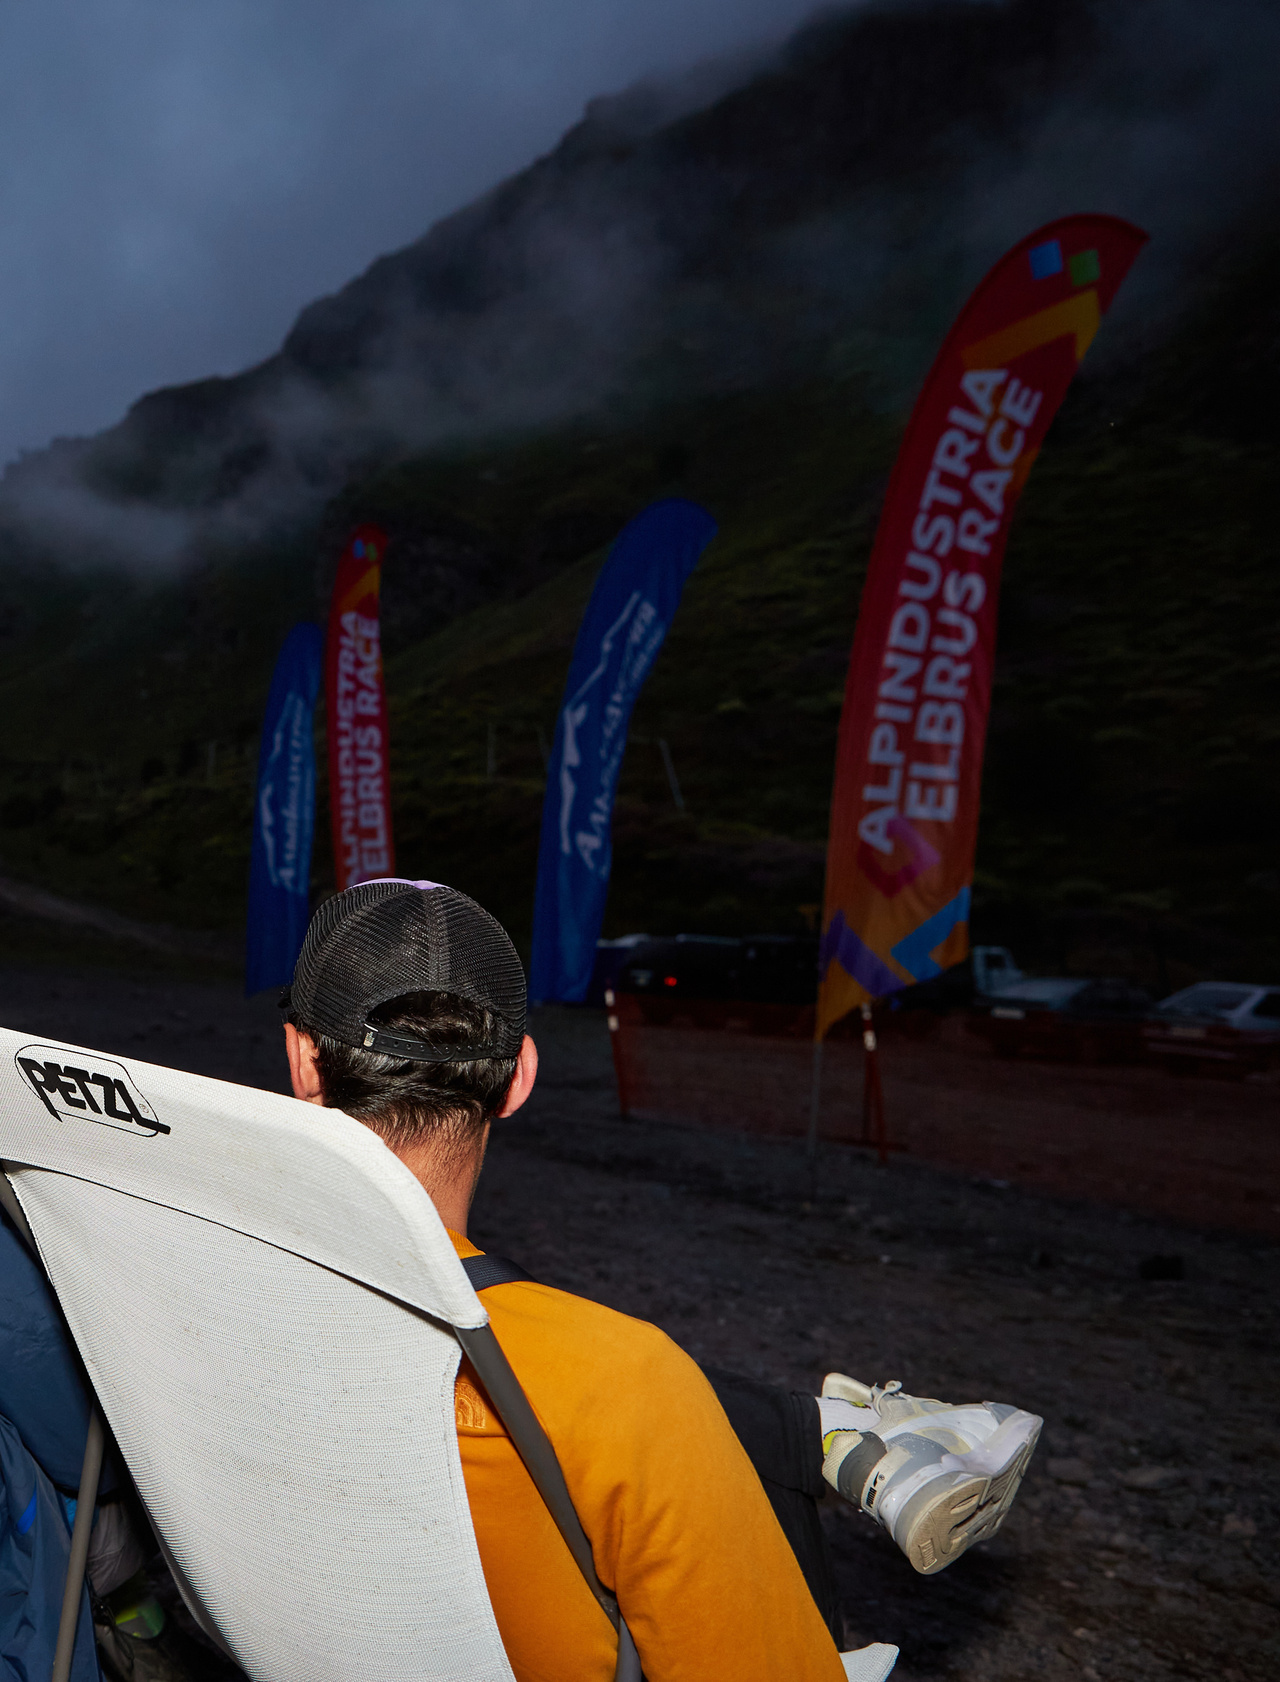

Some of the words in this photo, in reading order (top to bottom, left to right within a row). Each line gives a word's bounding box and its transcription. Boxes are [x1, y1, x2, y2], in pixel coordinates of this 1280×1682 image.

[354, 617, 382, 717] RACE
[858, 369, 1008, 855] ALPINDUSTRIA
[904, 570, 987, 823] ELBRUS
[956, 379, 1042, 557] RACE
[355, 723, 390, 874] ELBRUS
[17, 1056, 171, 1135] PETZL
